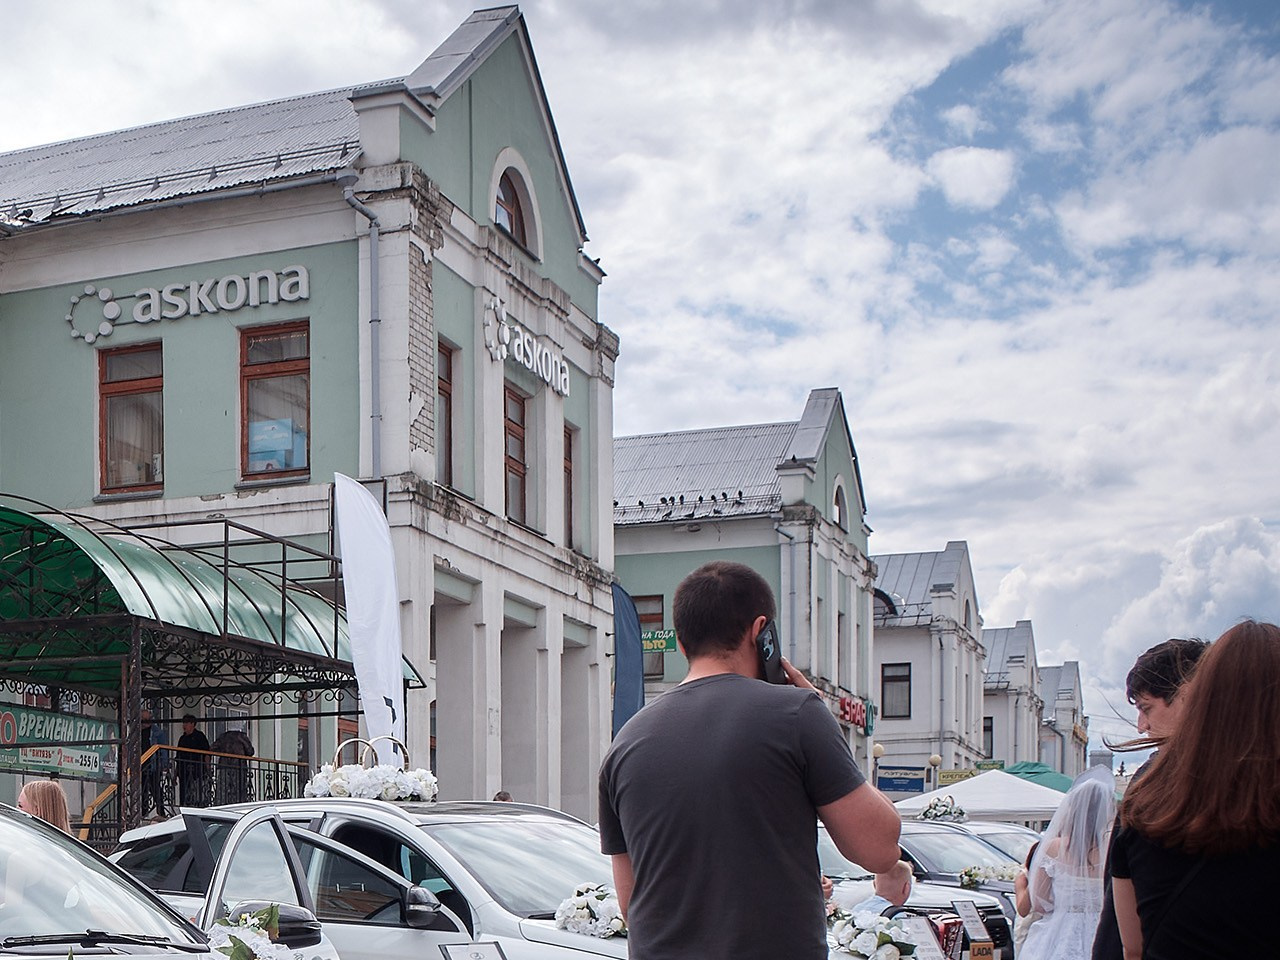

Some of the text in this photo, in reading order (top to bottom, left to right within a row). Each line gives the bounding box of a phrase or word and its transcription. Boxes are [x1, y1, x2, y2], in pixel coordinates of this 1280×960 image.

[132, 264, 310, 323] askona
[513, 325, 570, 397] askona
[18, 712, 75, 742] ВРЕМЕНА
[841, 697, 866, 728] SPAR
[80, 754, 98, 770] 255/6
[972, 946, 993, 957] LADA
